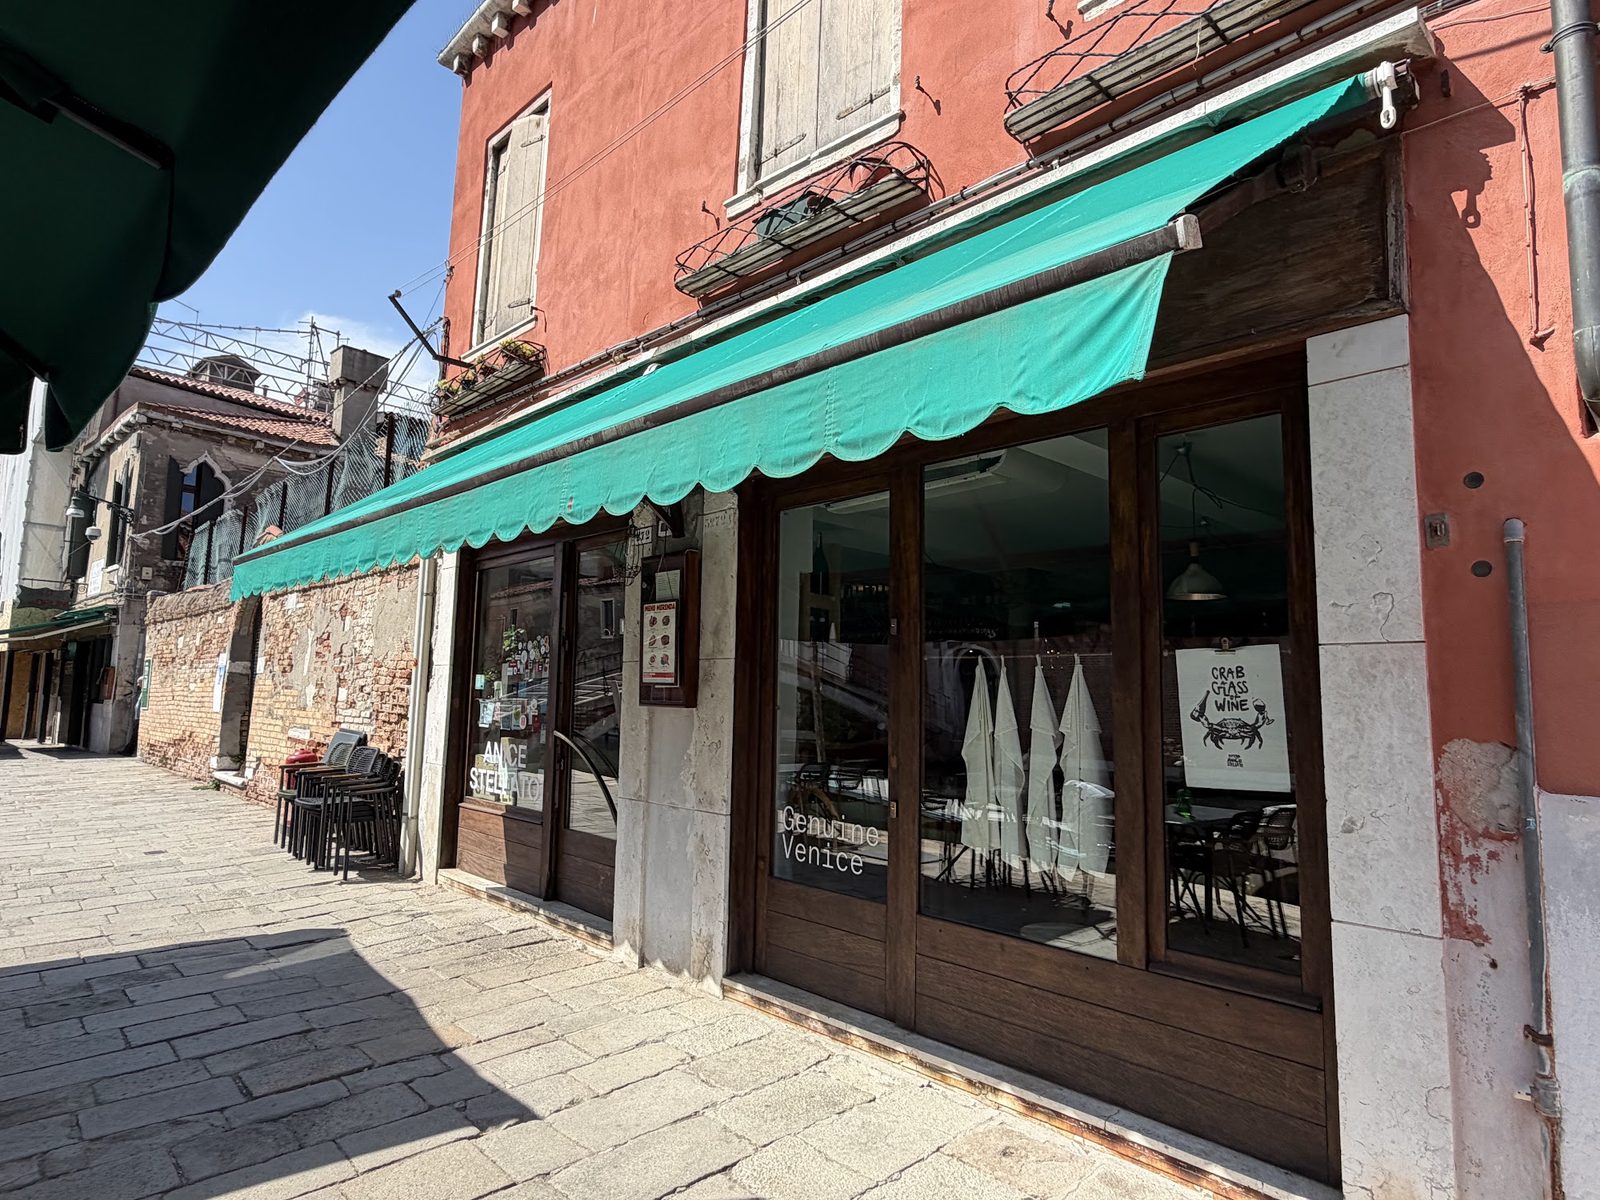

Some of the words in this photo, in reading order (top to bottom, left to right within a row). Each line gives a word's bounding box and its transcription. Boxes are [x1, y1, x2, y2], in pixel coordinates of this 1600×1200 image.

[1211, 665, 1245, 681] CRAB
[1211, 680, 1249, 697] GLASS
[1214, 697, 1250, 712] WINE
[469, 766, 540, 801] STELLATO
[782, 805, 880, 847] Genuine
[782, 833, 864, 876] Venice
